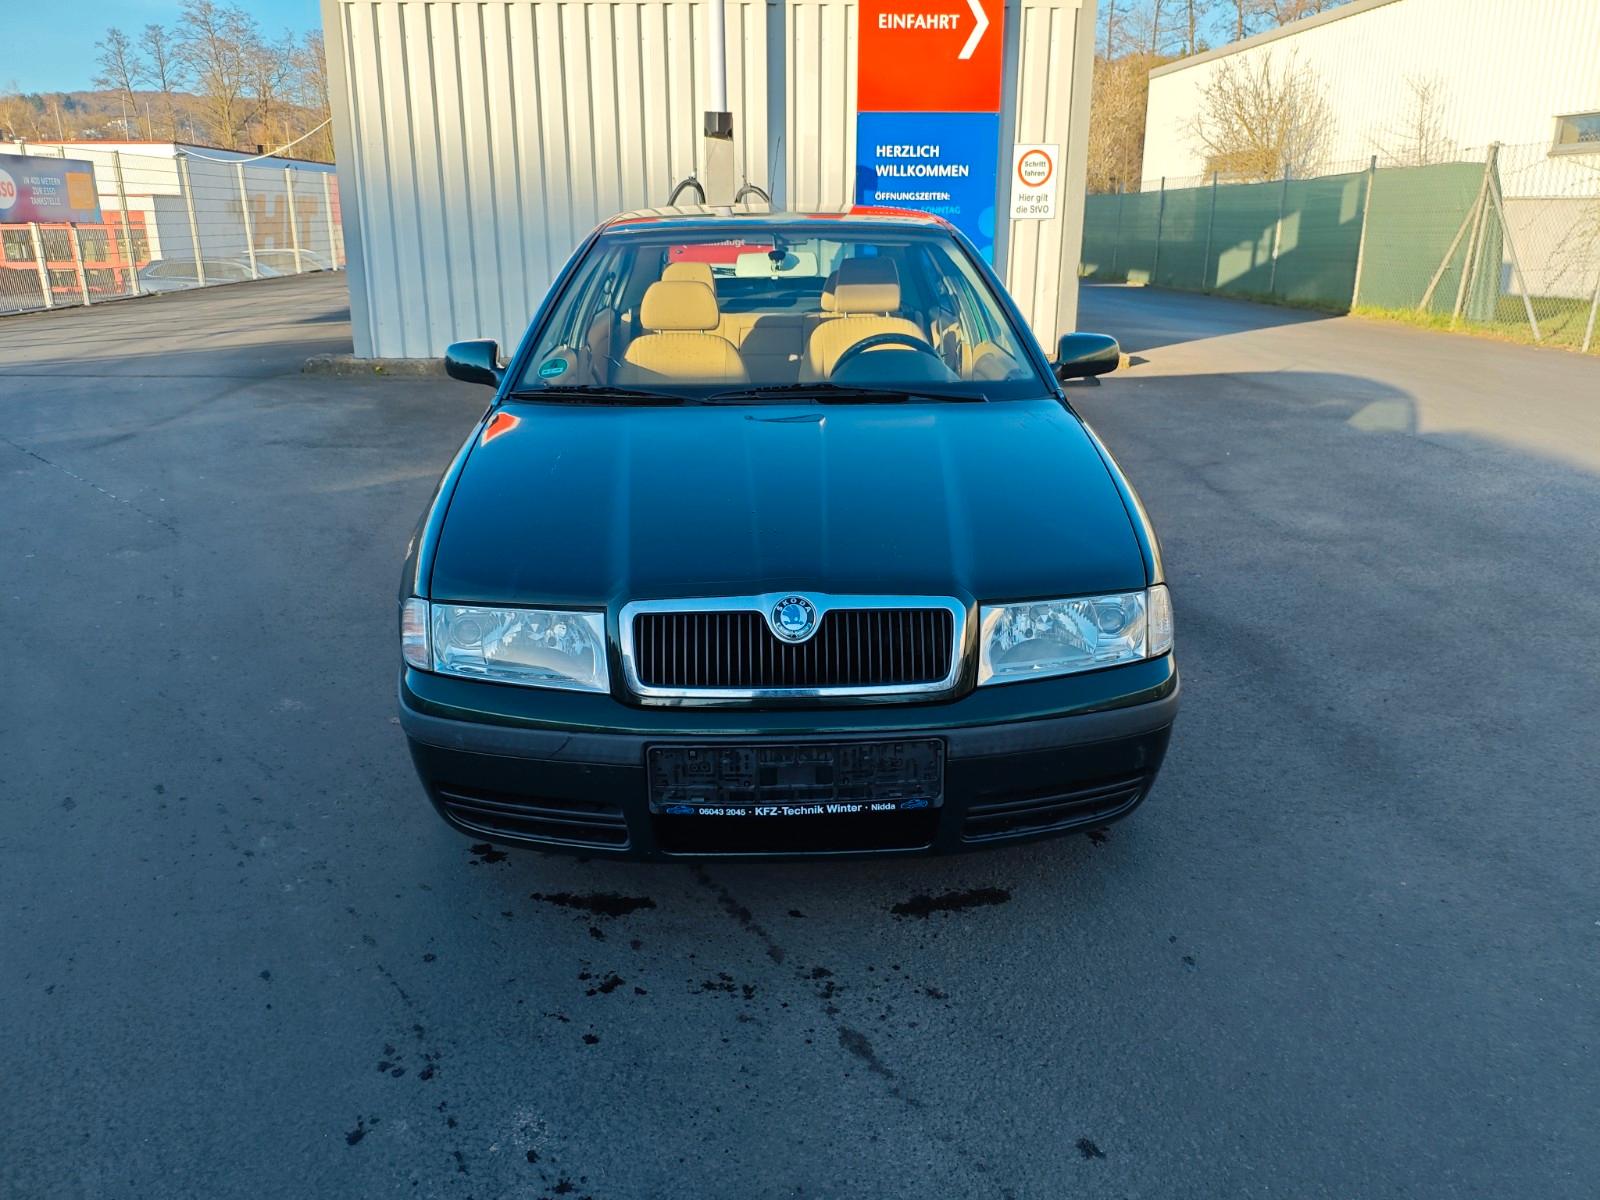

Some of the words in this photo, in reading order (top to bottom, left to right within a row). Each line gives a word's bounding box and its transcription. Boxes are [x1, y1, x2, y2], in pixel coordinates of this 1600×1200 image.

[878, 13, 960, 30] EINFAHRT
[876, 145, 940, 158] HERZLICH
[1024, 160, 1046, 168] Schritt
[875, 164, 969, 177] WILLKOMMEN
[874, 191, 951, 201] ÖFFNUNGSZEITEN:
[1018, 194, 1034, 202] Hier
[1036, 194, 1048, 203] gilt
[1016, 205, 1028, 214] die
[1029, 205, 1049, 214] StVO
[725, 808, 746, 816] 2045
[755, 806, 824, 816] KFZ-Technik
[826, 804, 863, 814] Winter
[871, 803, 896, 811] Nidda
